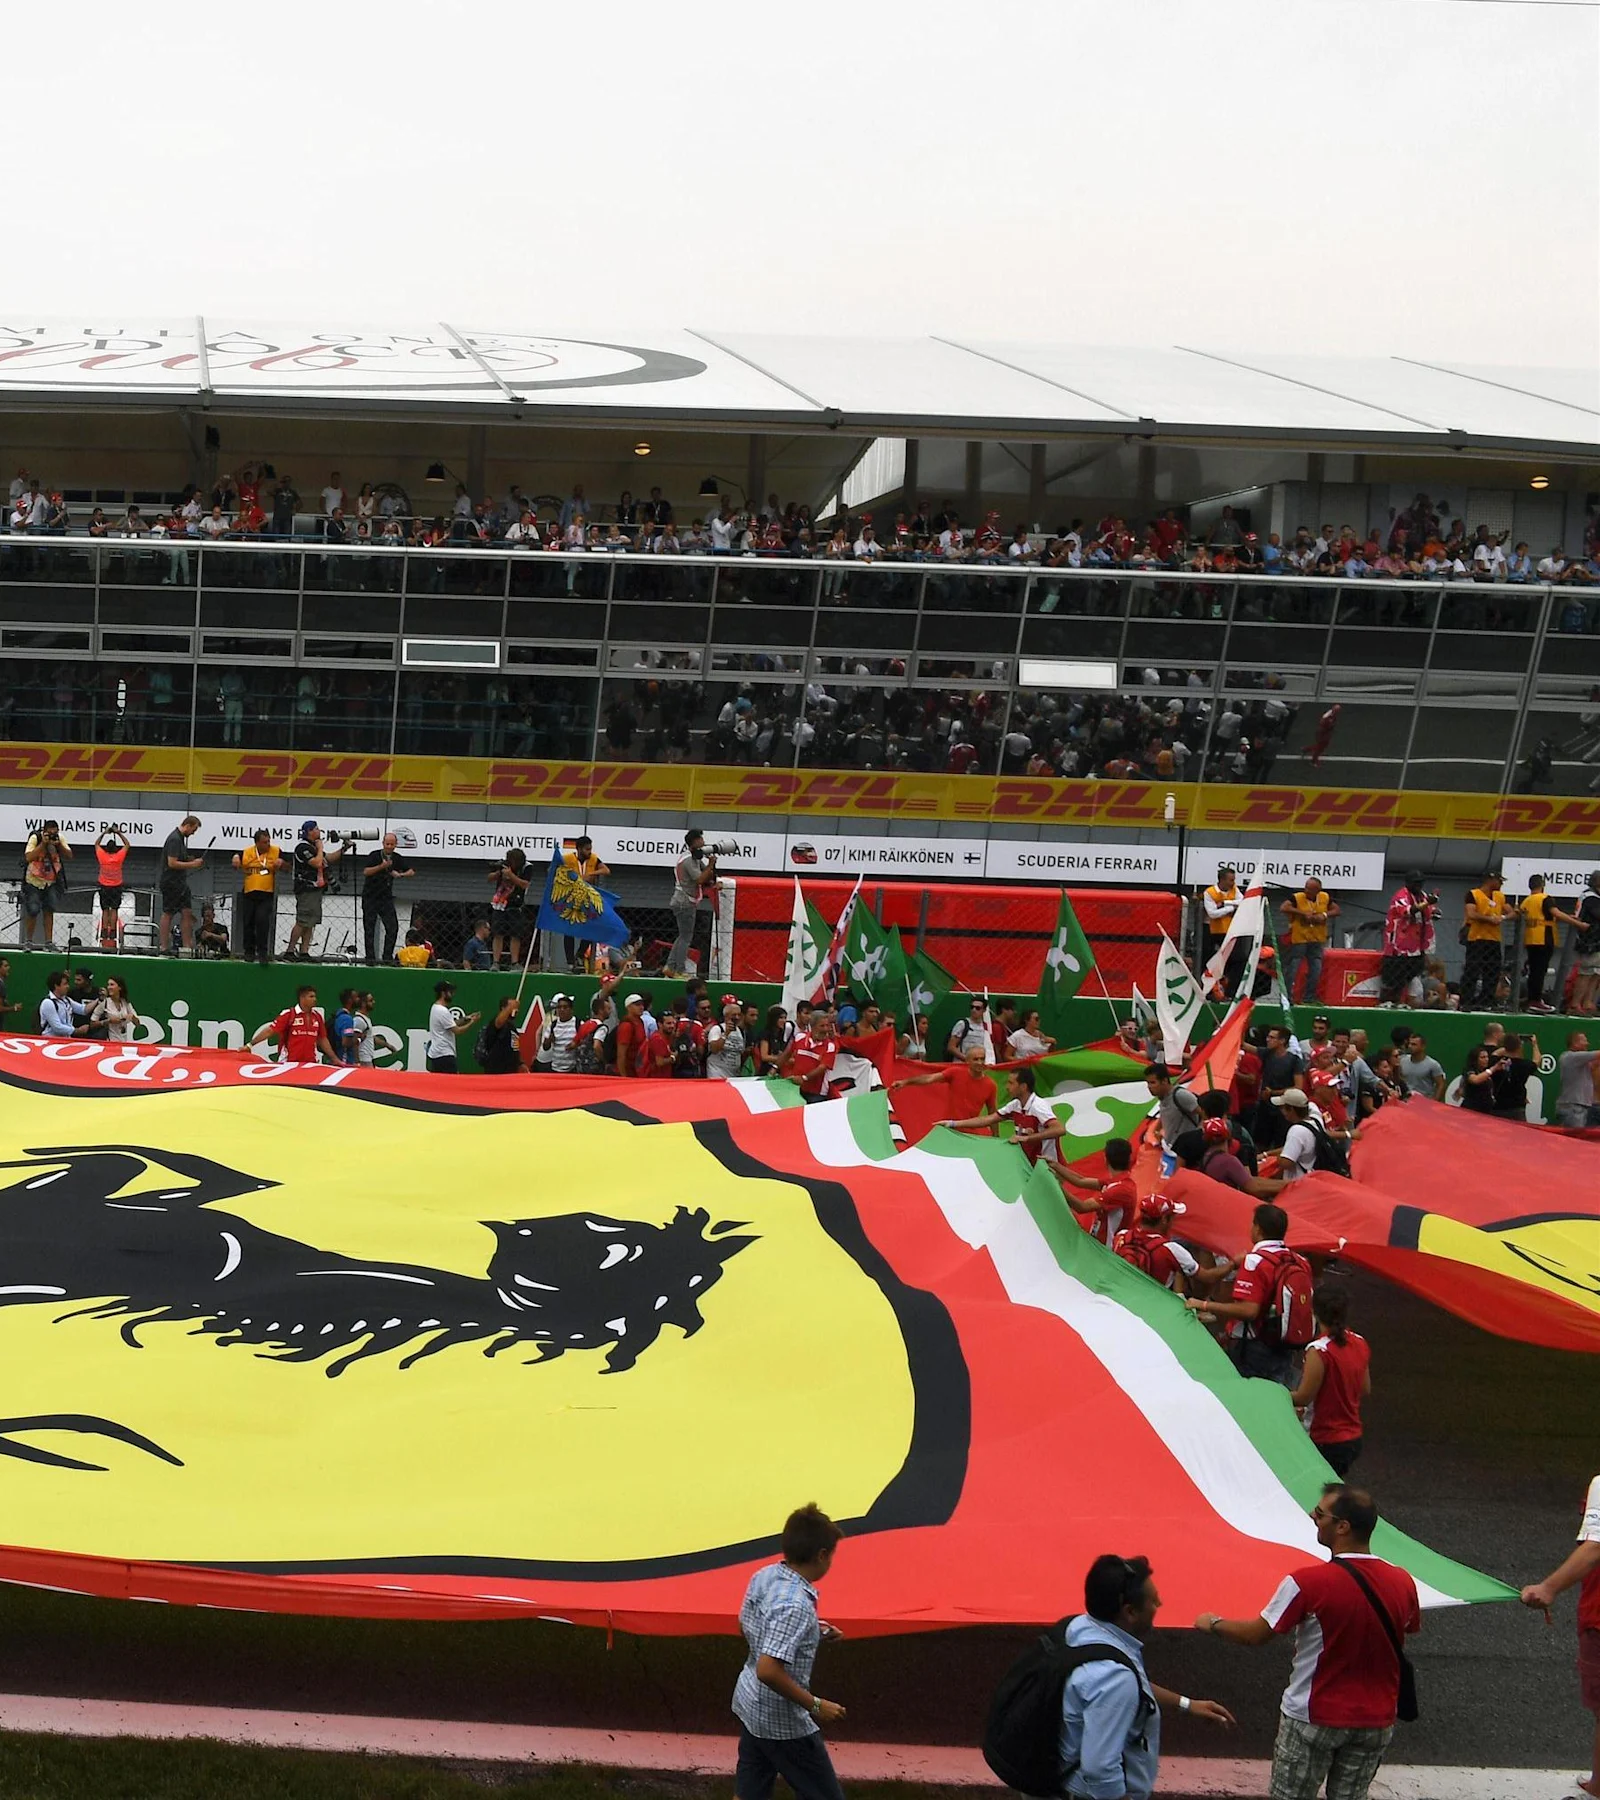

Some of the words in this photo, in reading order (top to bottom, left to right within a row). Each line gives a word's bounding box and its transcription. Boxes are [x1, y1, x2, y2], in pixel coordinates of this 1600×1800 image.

[312, 332, 500, 348] ONE
[234, 754, 402, 791] DHL
[485, 765, 656, 801] DHL
[735, 773, 904, 809] DHL
[990, 781, 1158, 819] DHL
[1234, 790, 1406, 827] DHL
[100, 821, 154, 835] RCING
[447, 834, 514, 848] SEBASTIAN
[848, 849, 876, 862] KIMI
[879, 847, 954, 864] RÄIKKÖNEN
[1017, 854, 1090, 869] SCUDERIA
[1094, 857, 1158, 871] FERRARI
[1294, 864, 1357, 877] FERRARI
